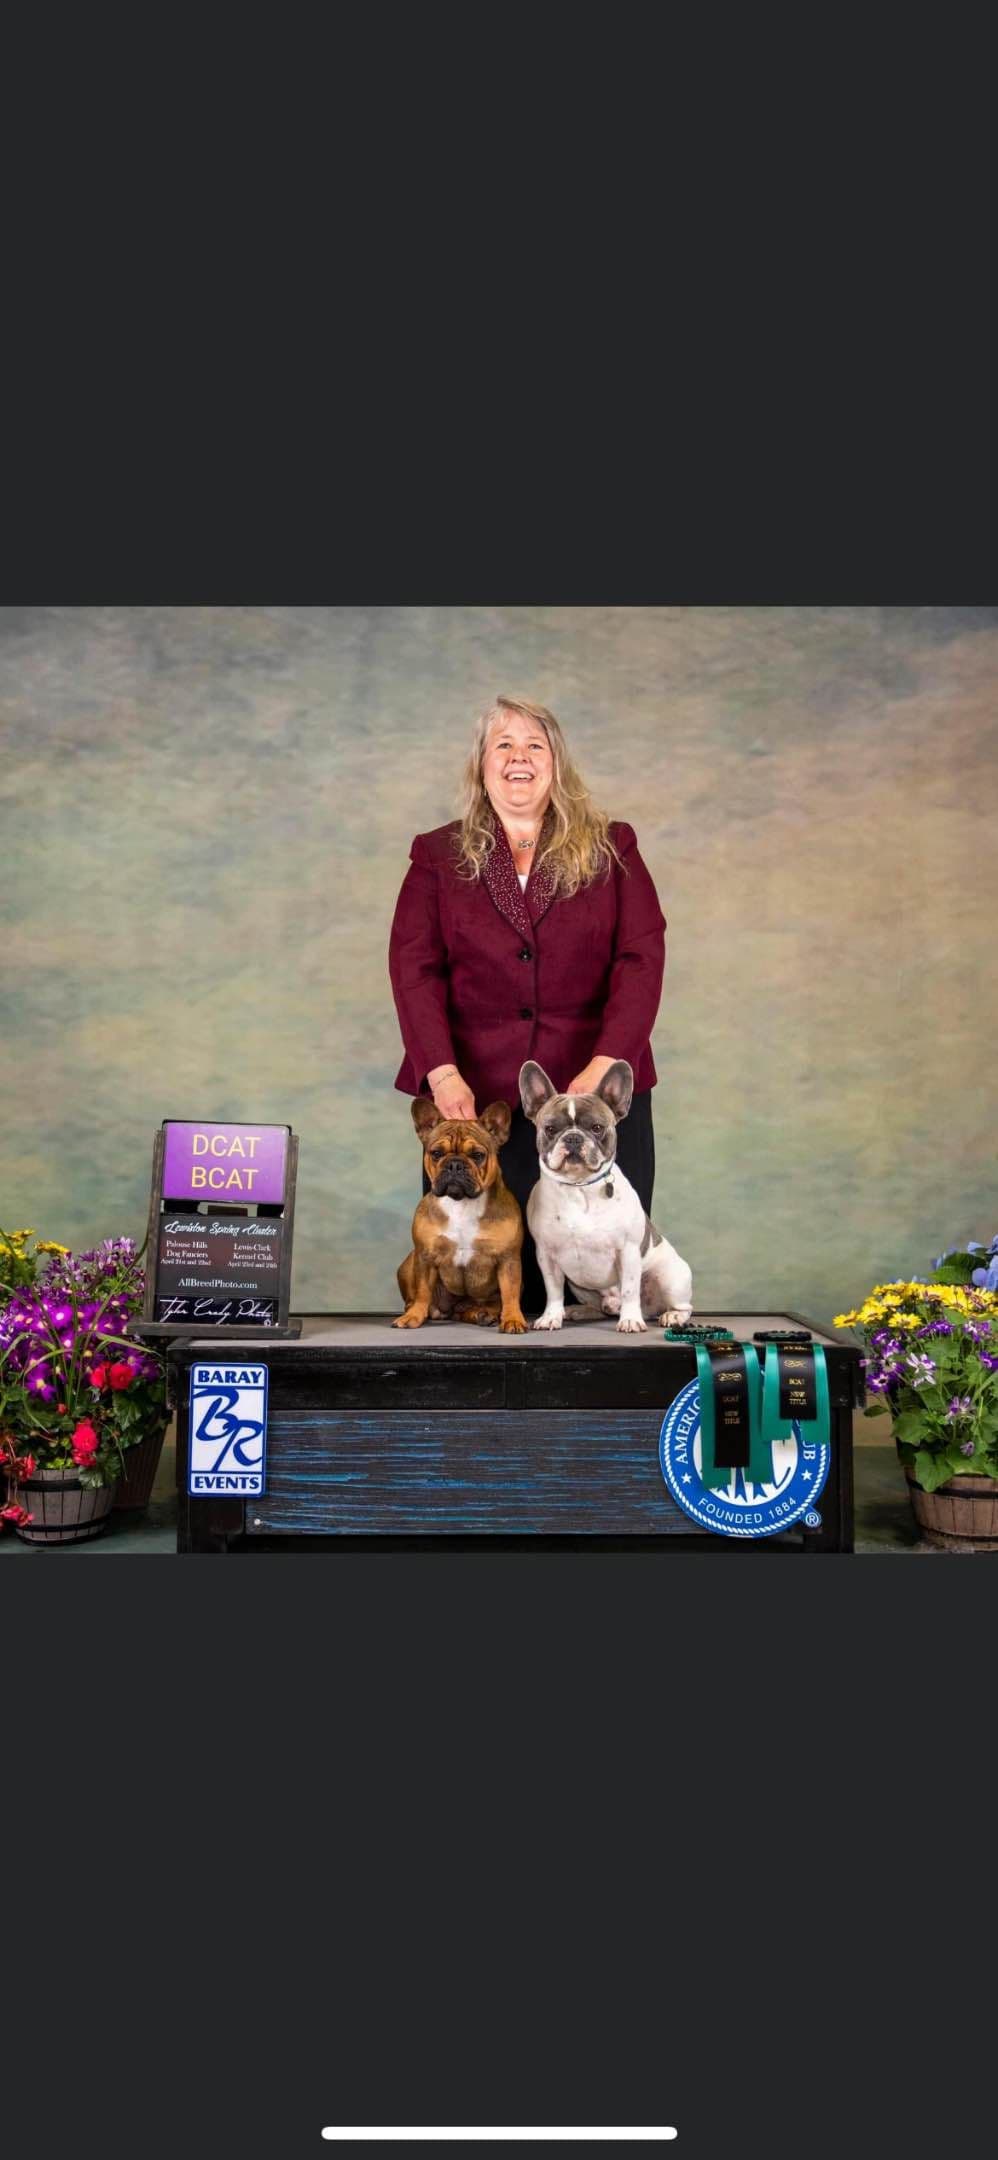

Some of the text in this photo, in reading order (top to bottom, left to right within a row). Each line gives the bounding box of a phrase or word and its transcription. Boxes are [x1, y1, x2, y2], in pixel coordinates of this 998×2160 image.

[192, 1134, 262, 1158] DCAT
[191, 1166, 259, 1190] BCAT
[209, 1222, 240, 1237] Spring
[166, 1240, 208, 1249] Palouse Hills
[166, 1250, 208, 1258] Dog Fanciers
[233, 1252, 273, 1261] Kennel Club
[178, 1278, 257, 1289] AllBreedPhoto.com
[197, 1370, 262, 1384] BARAY
[674, 1396, 701, 1465] AMERIC
[194, 1476, 259, 1490] EVENTS
[698, 1497, 796, 1524] FOUNDED 1884
